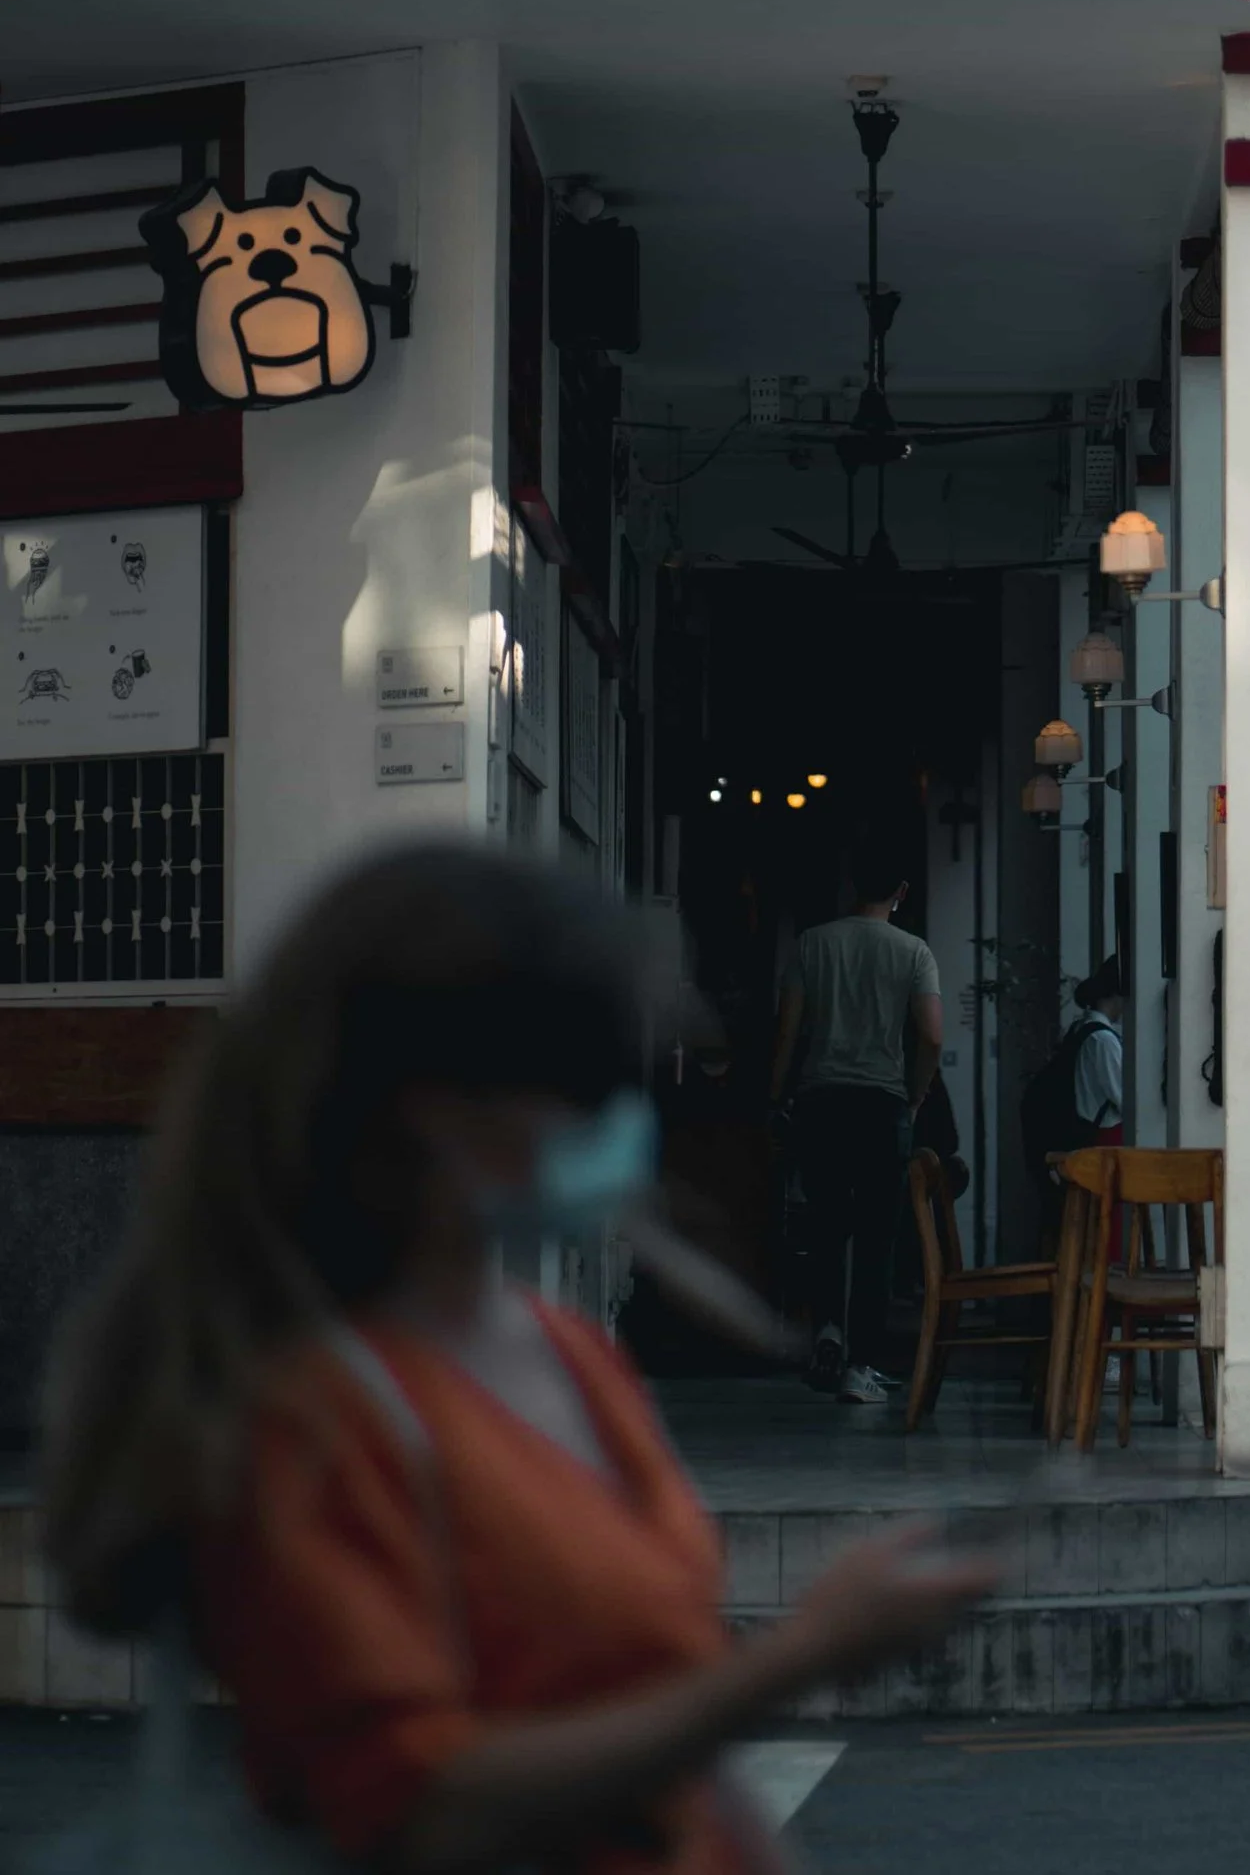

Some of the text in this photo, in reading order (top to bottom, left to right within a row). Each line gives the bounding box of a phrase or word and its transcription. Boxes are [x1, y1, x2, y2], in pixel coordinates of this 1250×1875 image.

[381, 687, 430, 701] ORDER HERE
[380, 764, 414, 776] CASHIER
